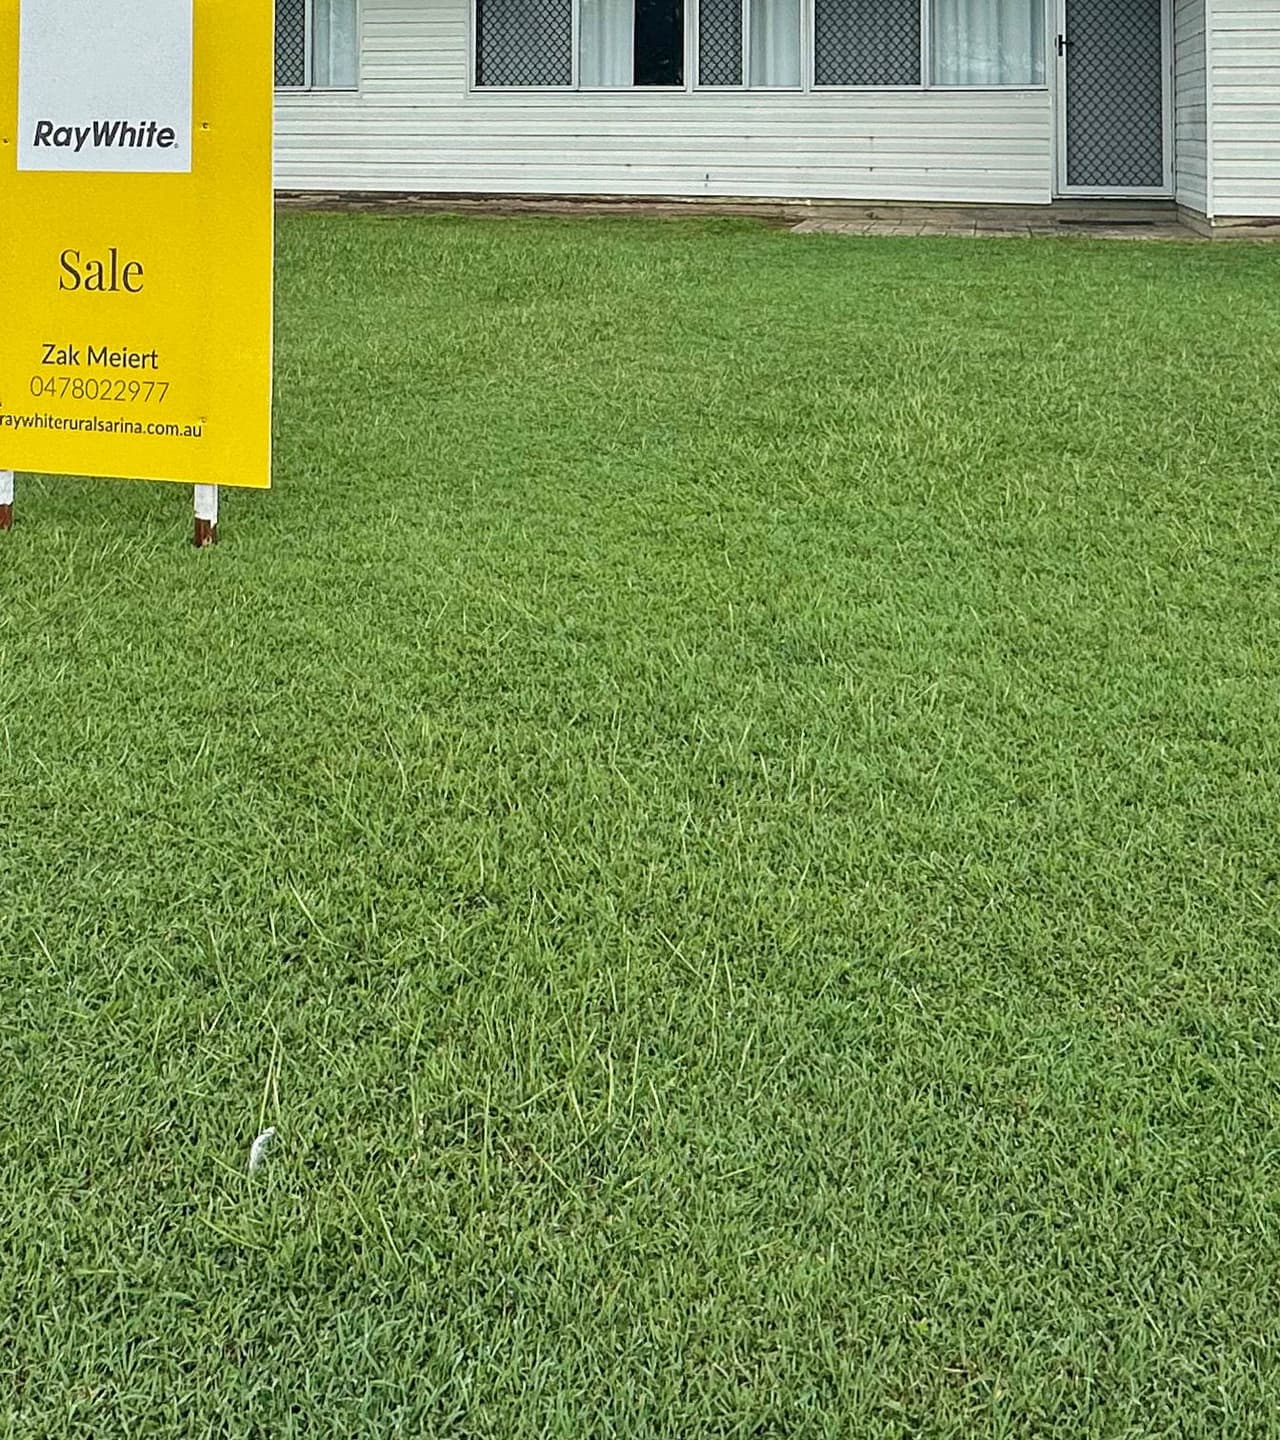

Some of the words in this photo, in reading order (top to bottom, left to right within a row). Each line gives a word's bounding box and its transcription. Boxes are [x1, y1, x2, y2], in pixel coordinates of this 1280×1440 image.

[59, 248, 144, 293] Sale
[42, 344, 81, 366] Zak
[87, 345, 159, 370] Meiert
[30, 376, 170, 403] 0478022977
[0, 412, 202, 438] raywhiteruralsarina.com.au
